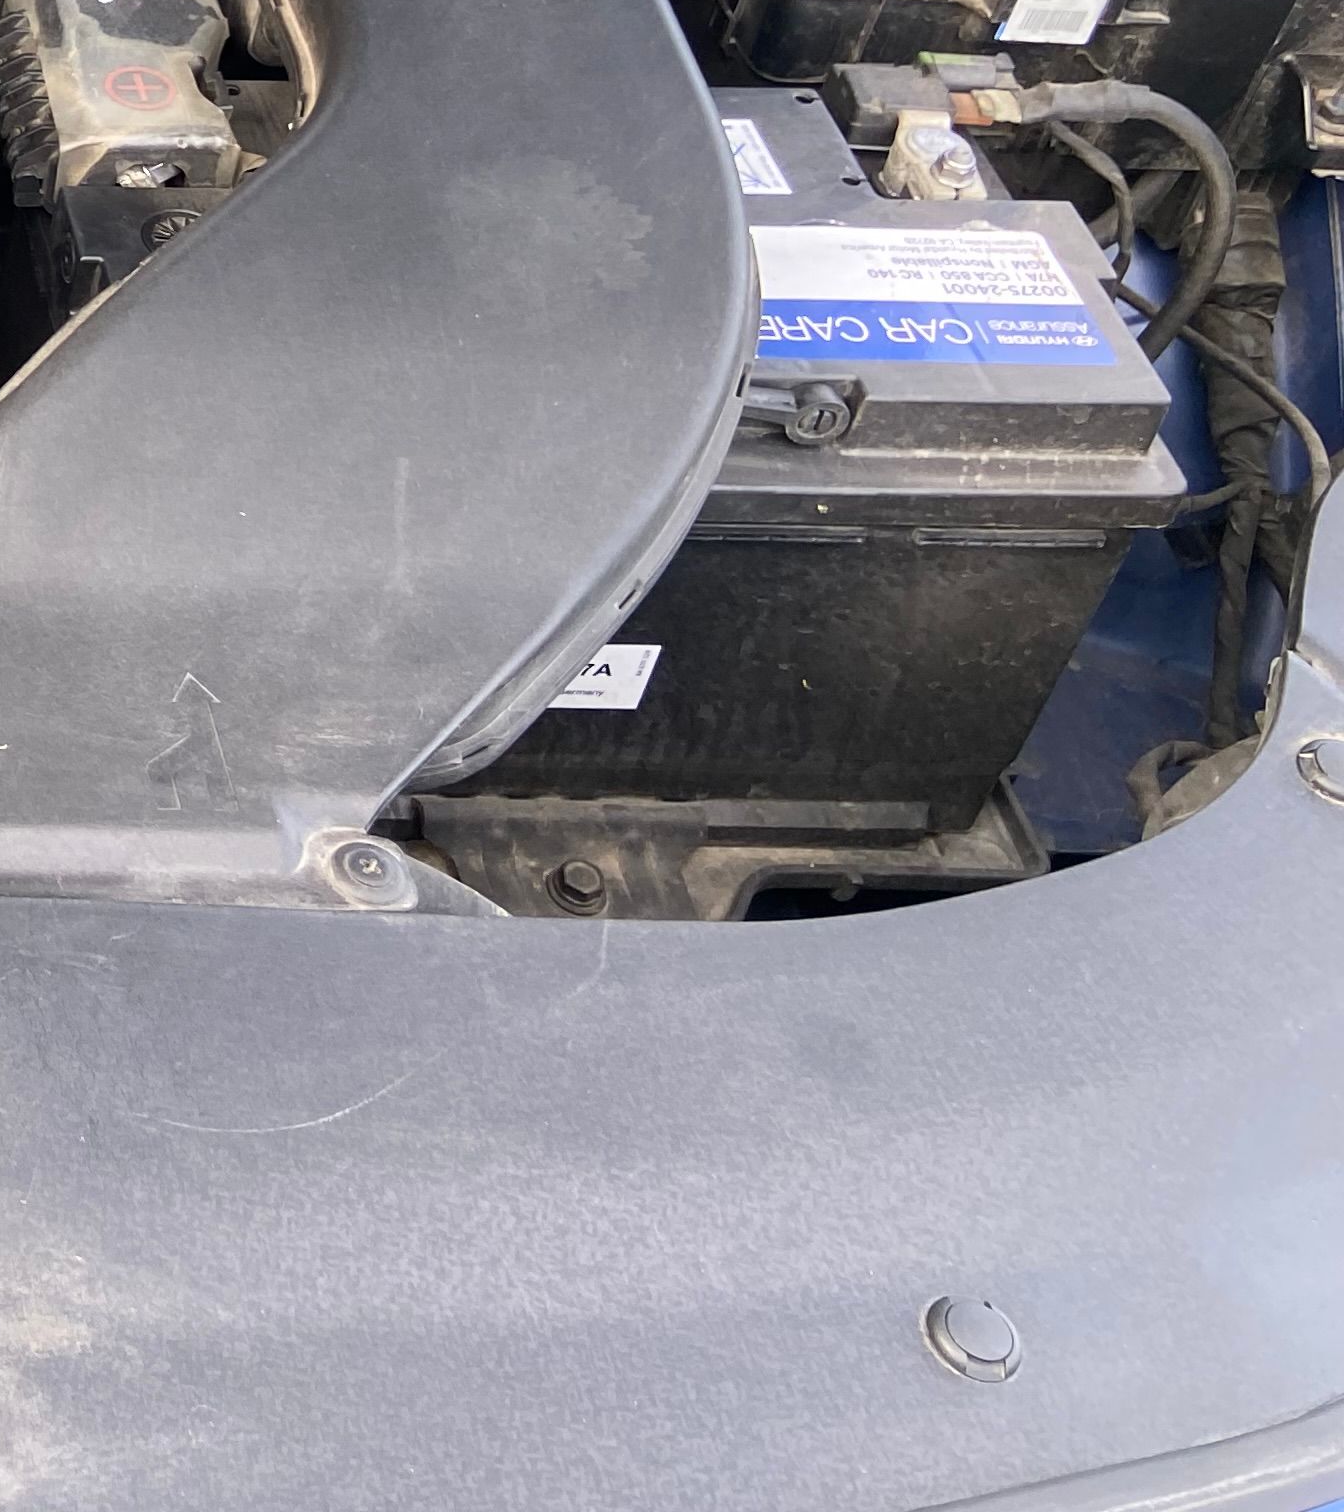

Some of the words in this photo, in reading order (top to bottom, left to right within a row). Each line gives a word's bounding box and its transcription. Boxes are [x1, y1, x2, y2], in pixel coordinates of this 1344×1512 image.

[899, 269, 924, 280] RC
[974, 271, 1010, 281] CCA
[942, 283, 1068, 297] 00275-24001
[758, 315, 869, 342] CARE
[878, 317, 973, 345] CAR
[988, 319, 1088, 334] Assurance
[996, 335, 1070, 345] HYUNDAI
[580, 663, 612, 677] 7A
